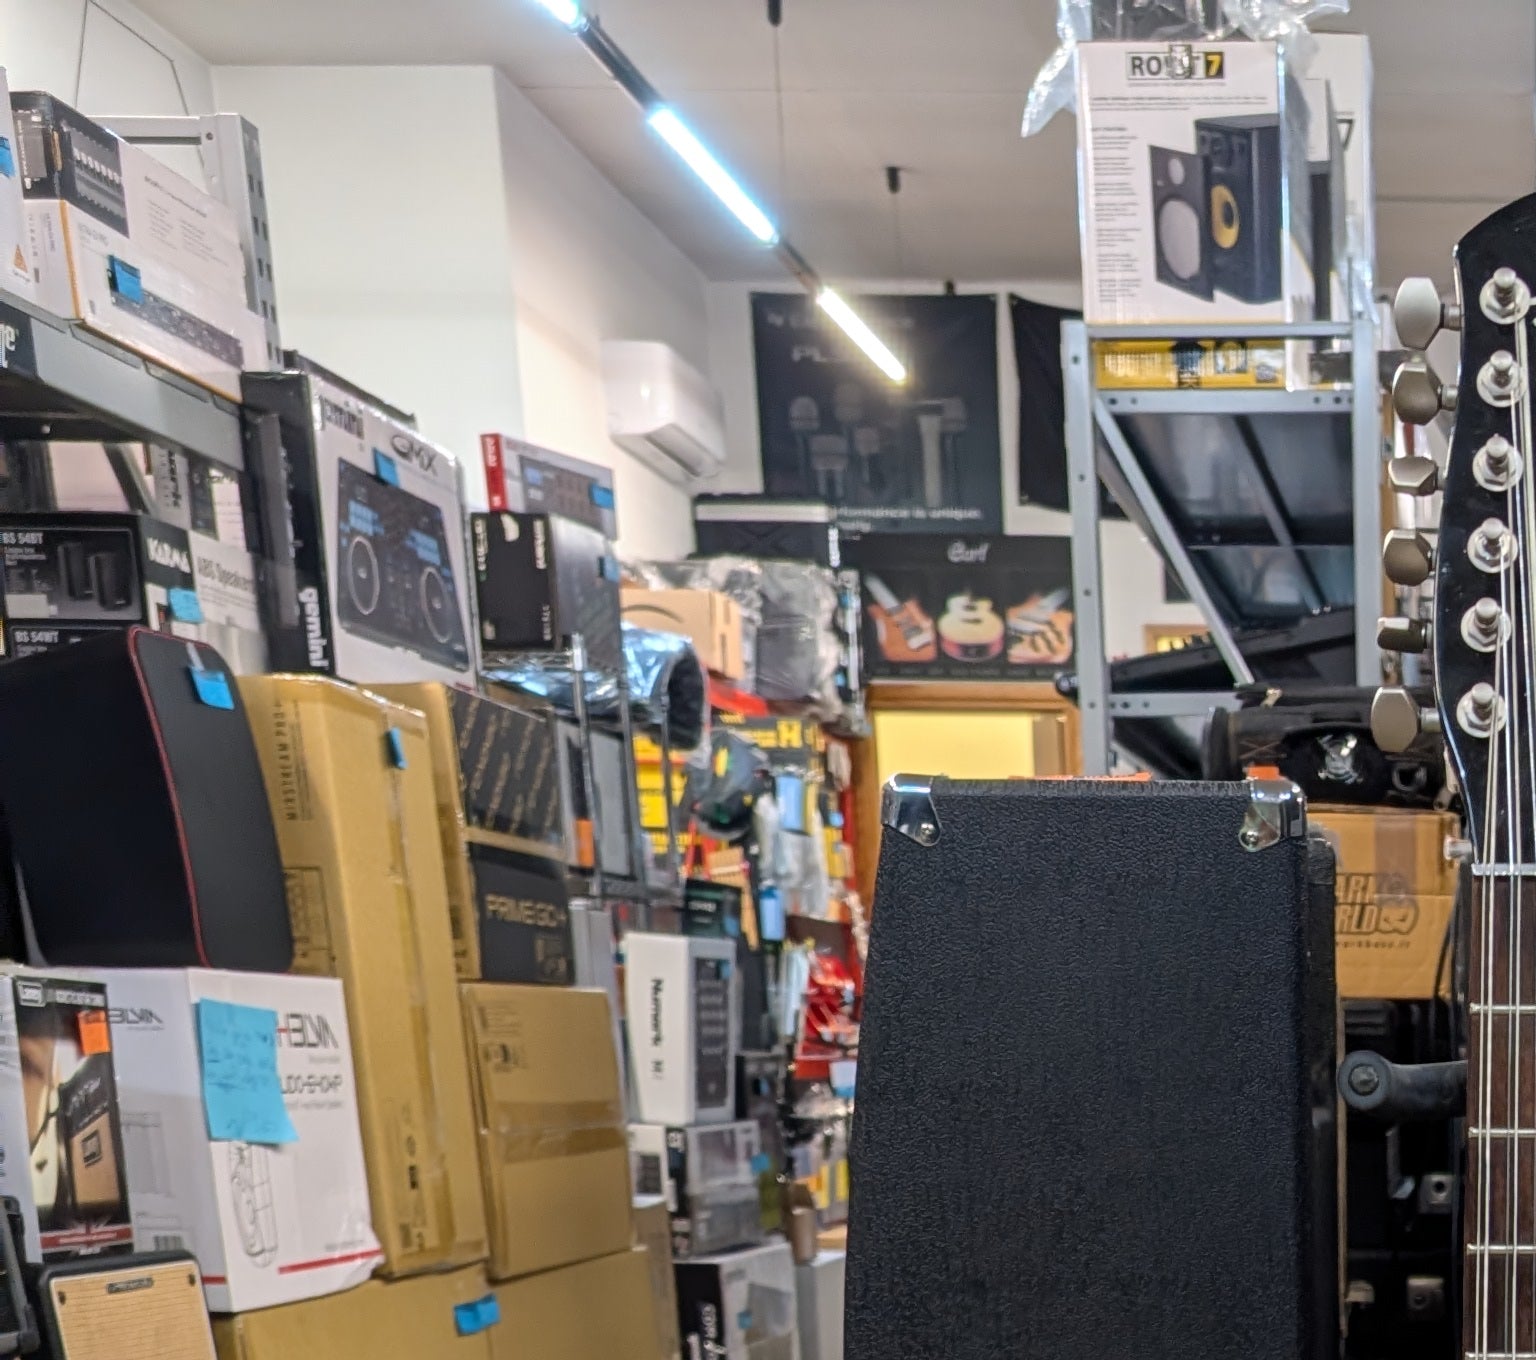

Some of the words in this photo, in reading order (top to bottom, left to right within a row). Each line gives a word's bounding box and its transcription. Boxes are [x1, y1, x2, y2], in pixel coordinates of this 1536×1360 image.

[1206, 54, 1222, 76] 7
[300, 587, 330, 668] gemini
[650, 978, 667, 1047] Numark
